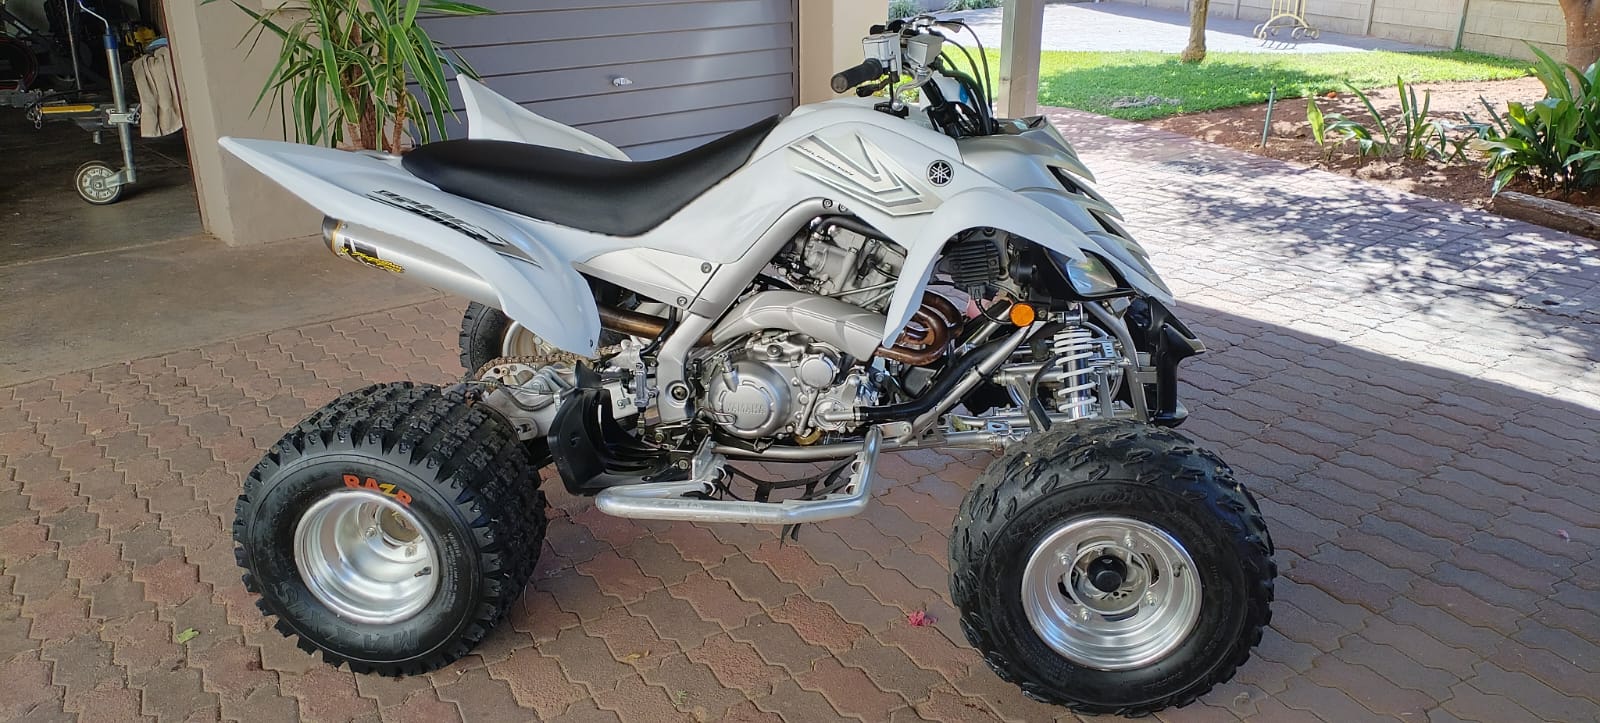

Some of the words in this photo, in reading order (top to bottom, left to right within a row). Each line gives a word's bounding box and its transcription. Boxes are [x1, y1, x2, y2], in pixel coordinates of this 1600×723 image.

[726, 402, 766, 414] YAMAHA
[343, 474, 413, 508] RAZR
[274, 580, 420, 655] MAXXIS
